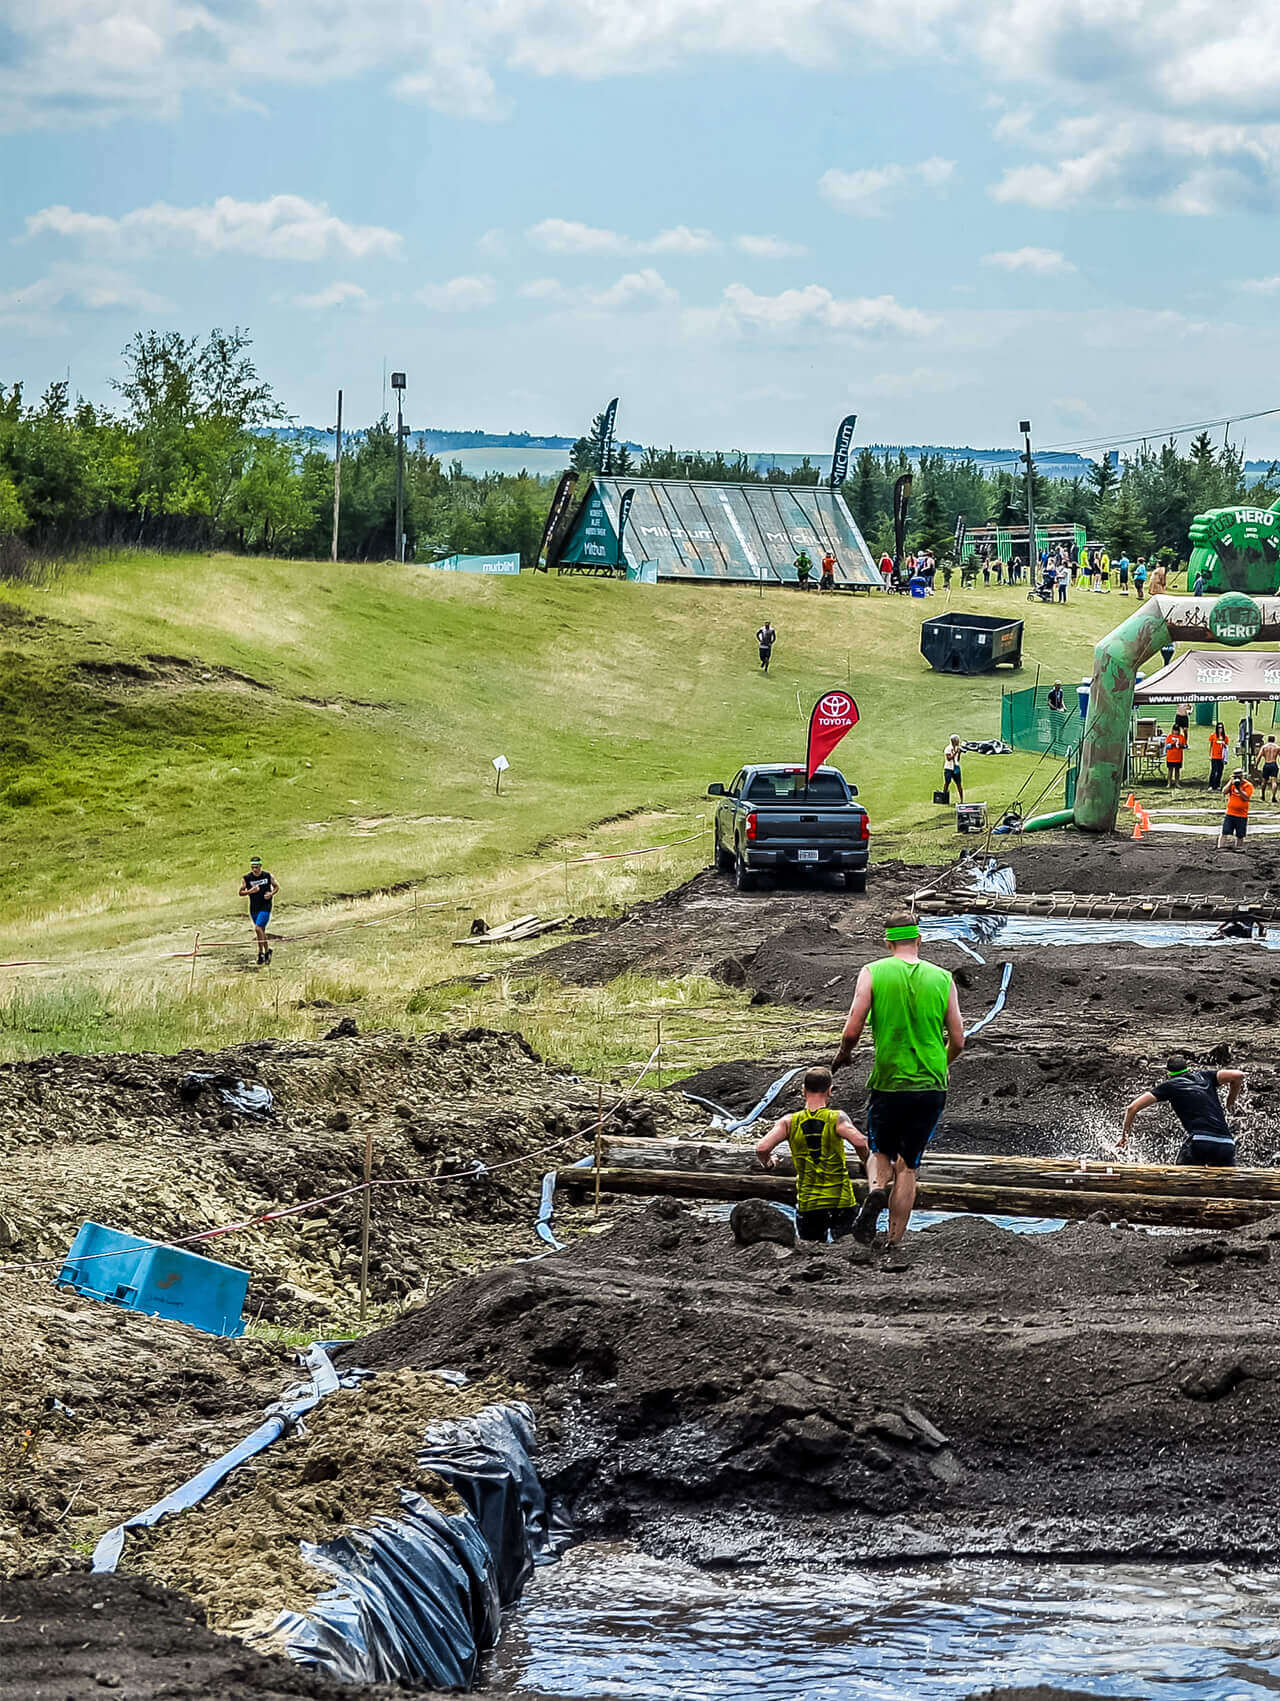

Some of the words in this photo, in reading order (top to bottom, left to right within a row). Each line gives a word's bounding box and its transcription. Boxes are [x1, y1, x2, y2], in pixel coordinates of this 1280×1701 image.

[1235, 511, 1274, 526] HERO
[1216, 624, 1257, 638] HERO
[1149, 694, 1236, 703] www.mudhero.com
[818, 718, 852, 726] TOYOTA
